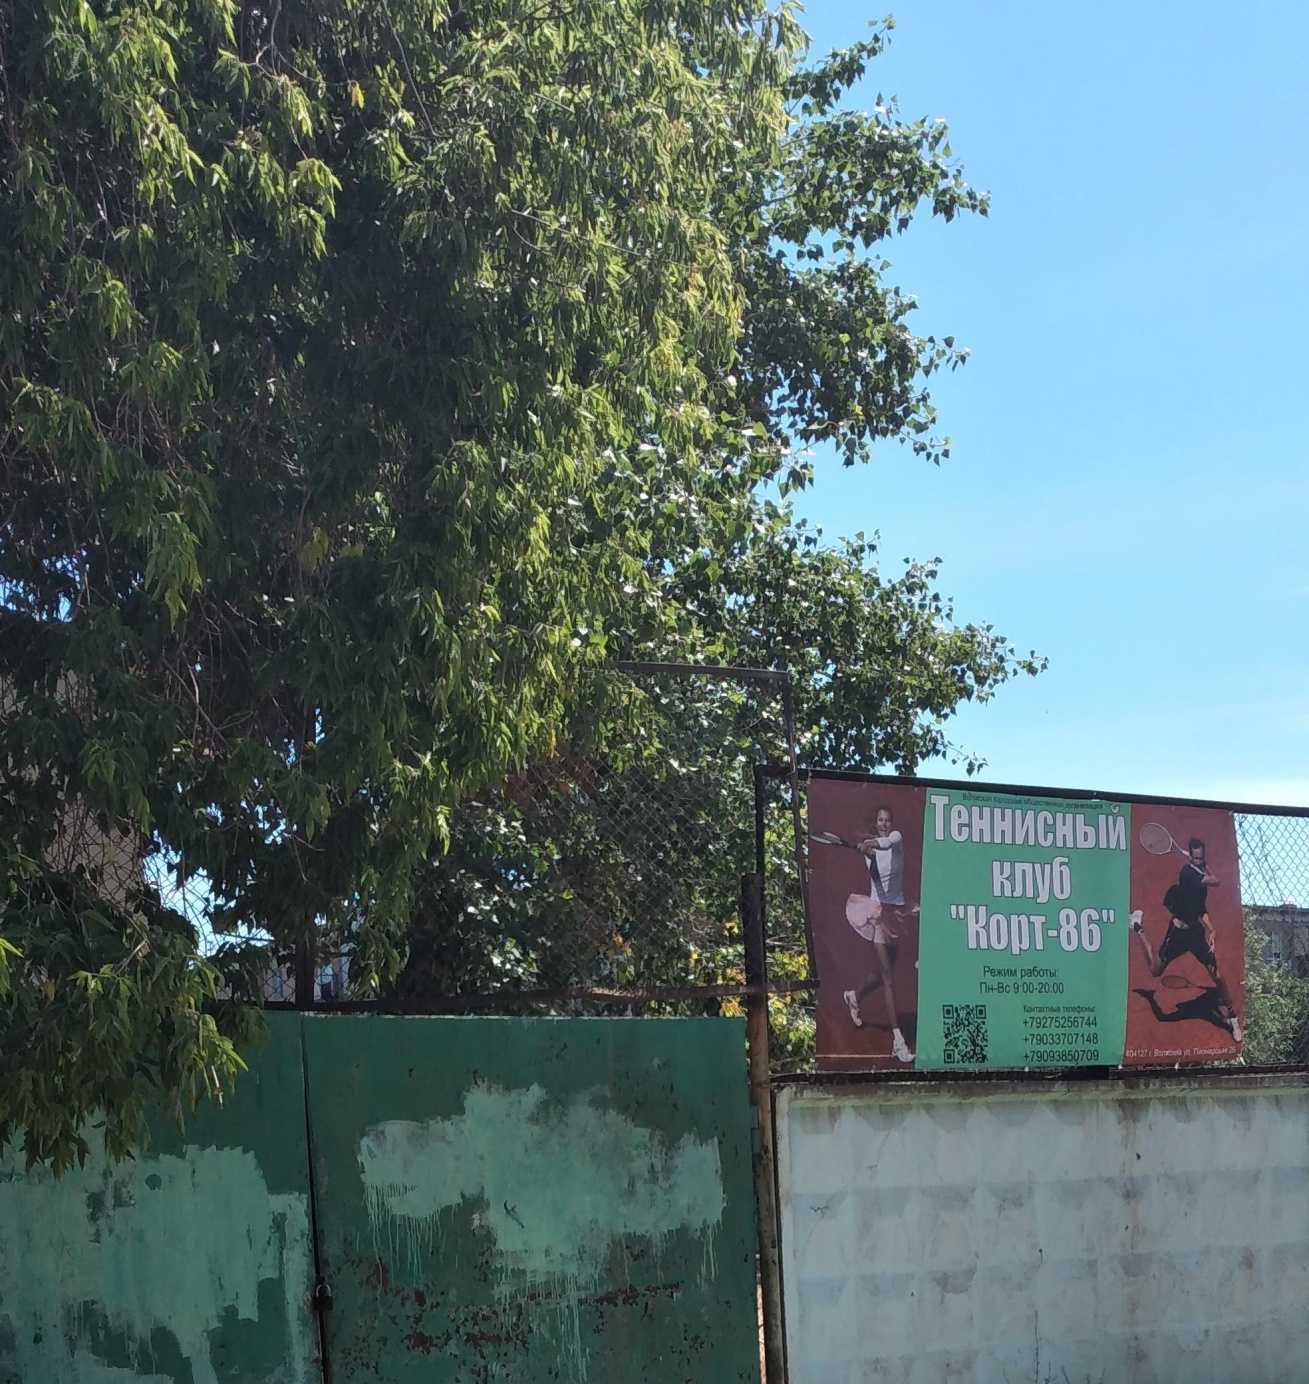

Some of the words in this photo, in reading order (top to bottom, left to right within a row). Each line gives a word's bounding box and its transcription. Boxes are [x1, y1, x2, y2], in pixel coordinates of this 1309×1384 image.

[930, 794, 1127, 850] Теннисный
[991, 856, 1072, 904] клуб
[949, 903, 1116, 955] "Корт-86"
[983, 965, 1018, 978] Режим
[979, 981, 1010, 994] Пн-Вс
[1023, 1015, 1097, 1029] +79275256744
[1023, 1032, 1099, 1046] +79033707148
[1024, 1049, 1100, 1063] +79093850709
